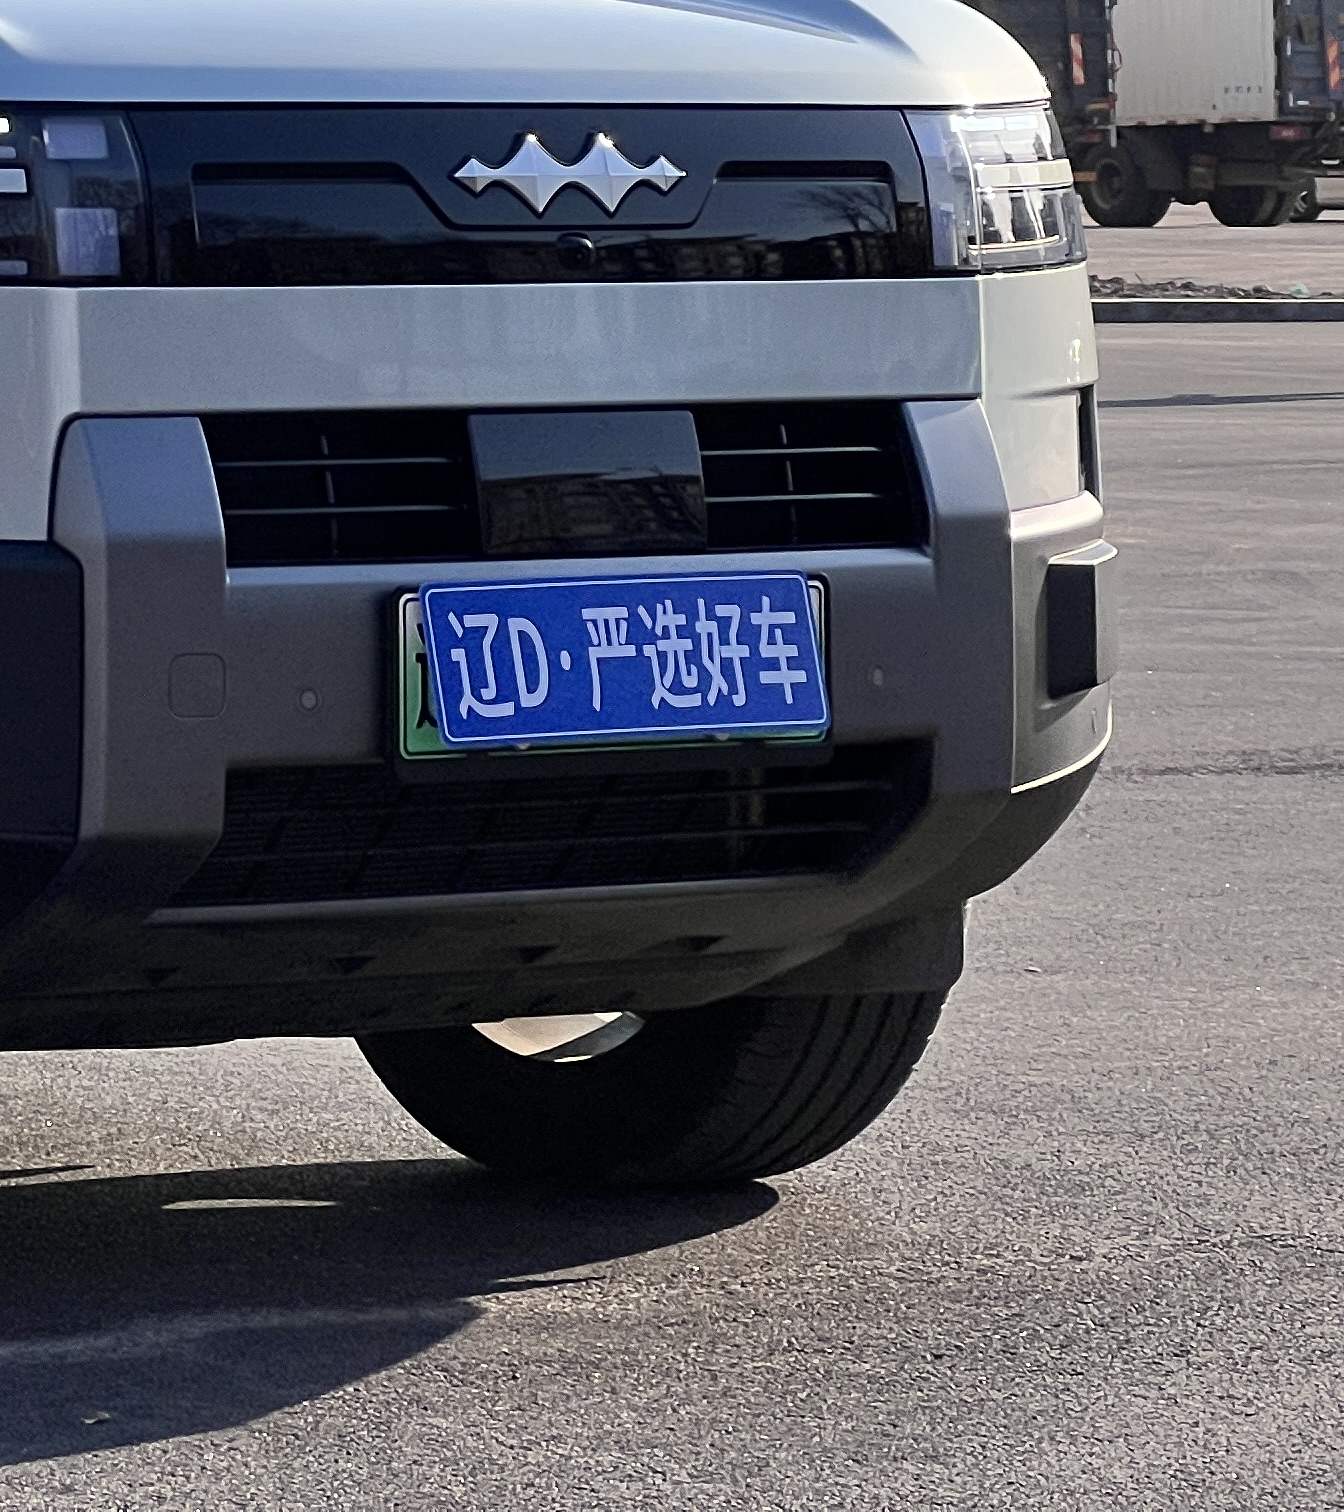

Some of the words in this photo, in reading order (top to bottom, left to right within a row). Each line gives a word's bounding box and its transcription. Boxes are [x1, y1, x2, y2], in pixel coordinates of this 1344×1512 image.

[447, 595, 808, 718] 辽D·严选好车
